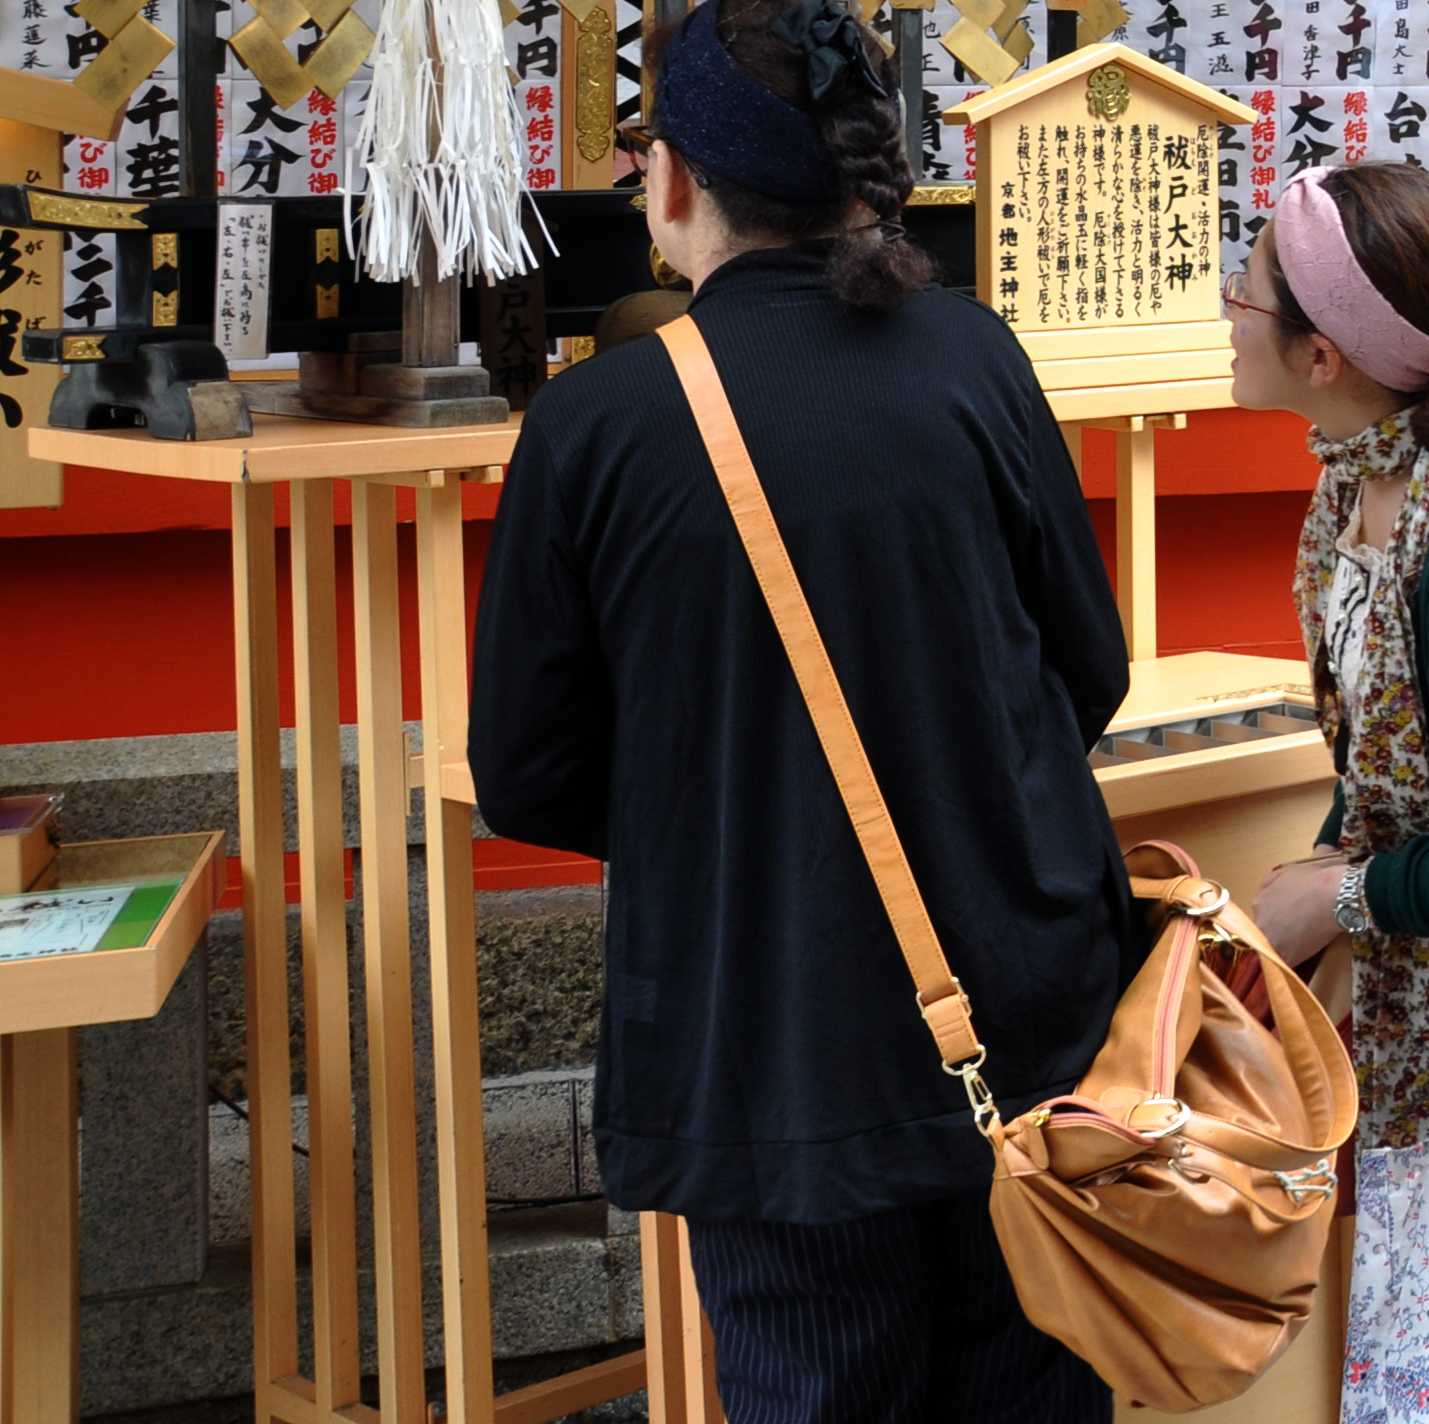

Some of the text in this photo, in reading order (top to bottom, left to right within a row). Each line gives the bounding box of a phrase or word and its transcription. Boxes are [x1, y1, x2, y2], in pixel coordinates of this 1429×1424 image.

[1163, 135, 1193, 293] 祓戸大神
[1250, 91, 1276, 209] 縁結び御礼
